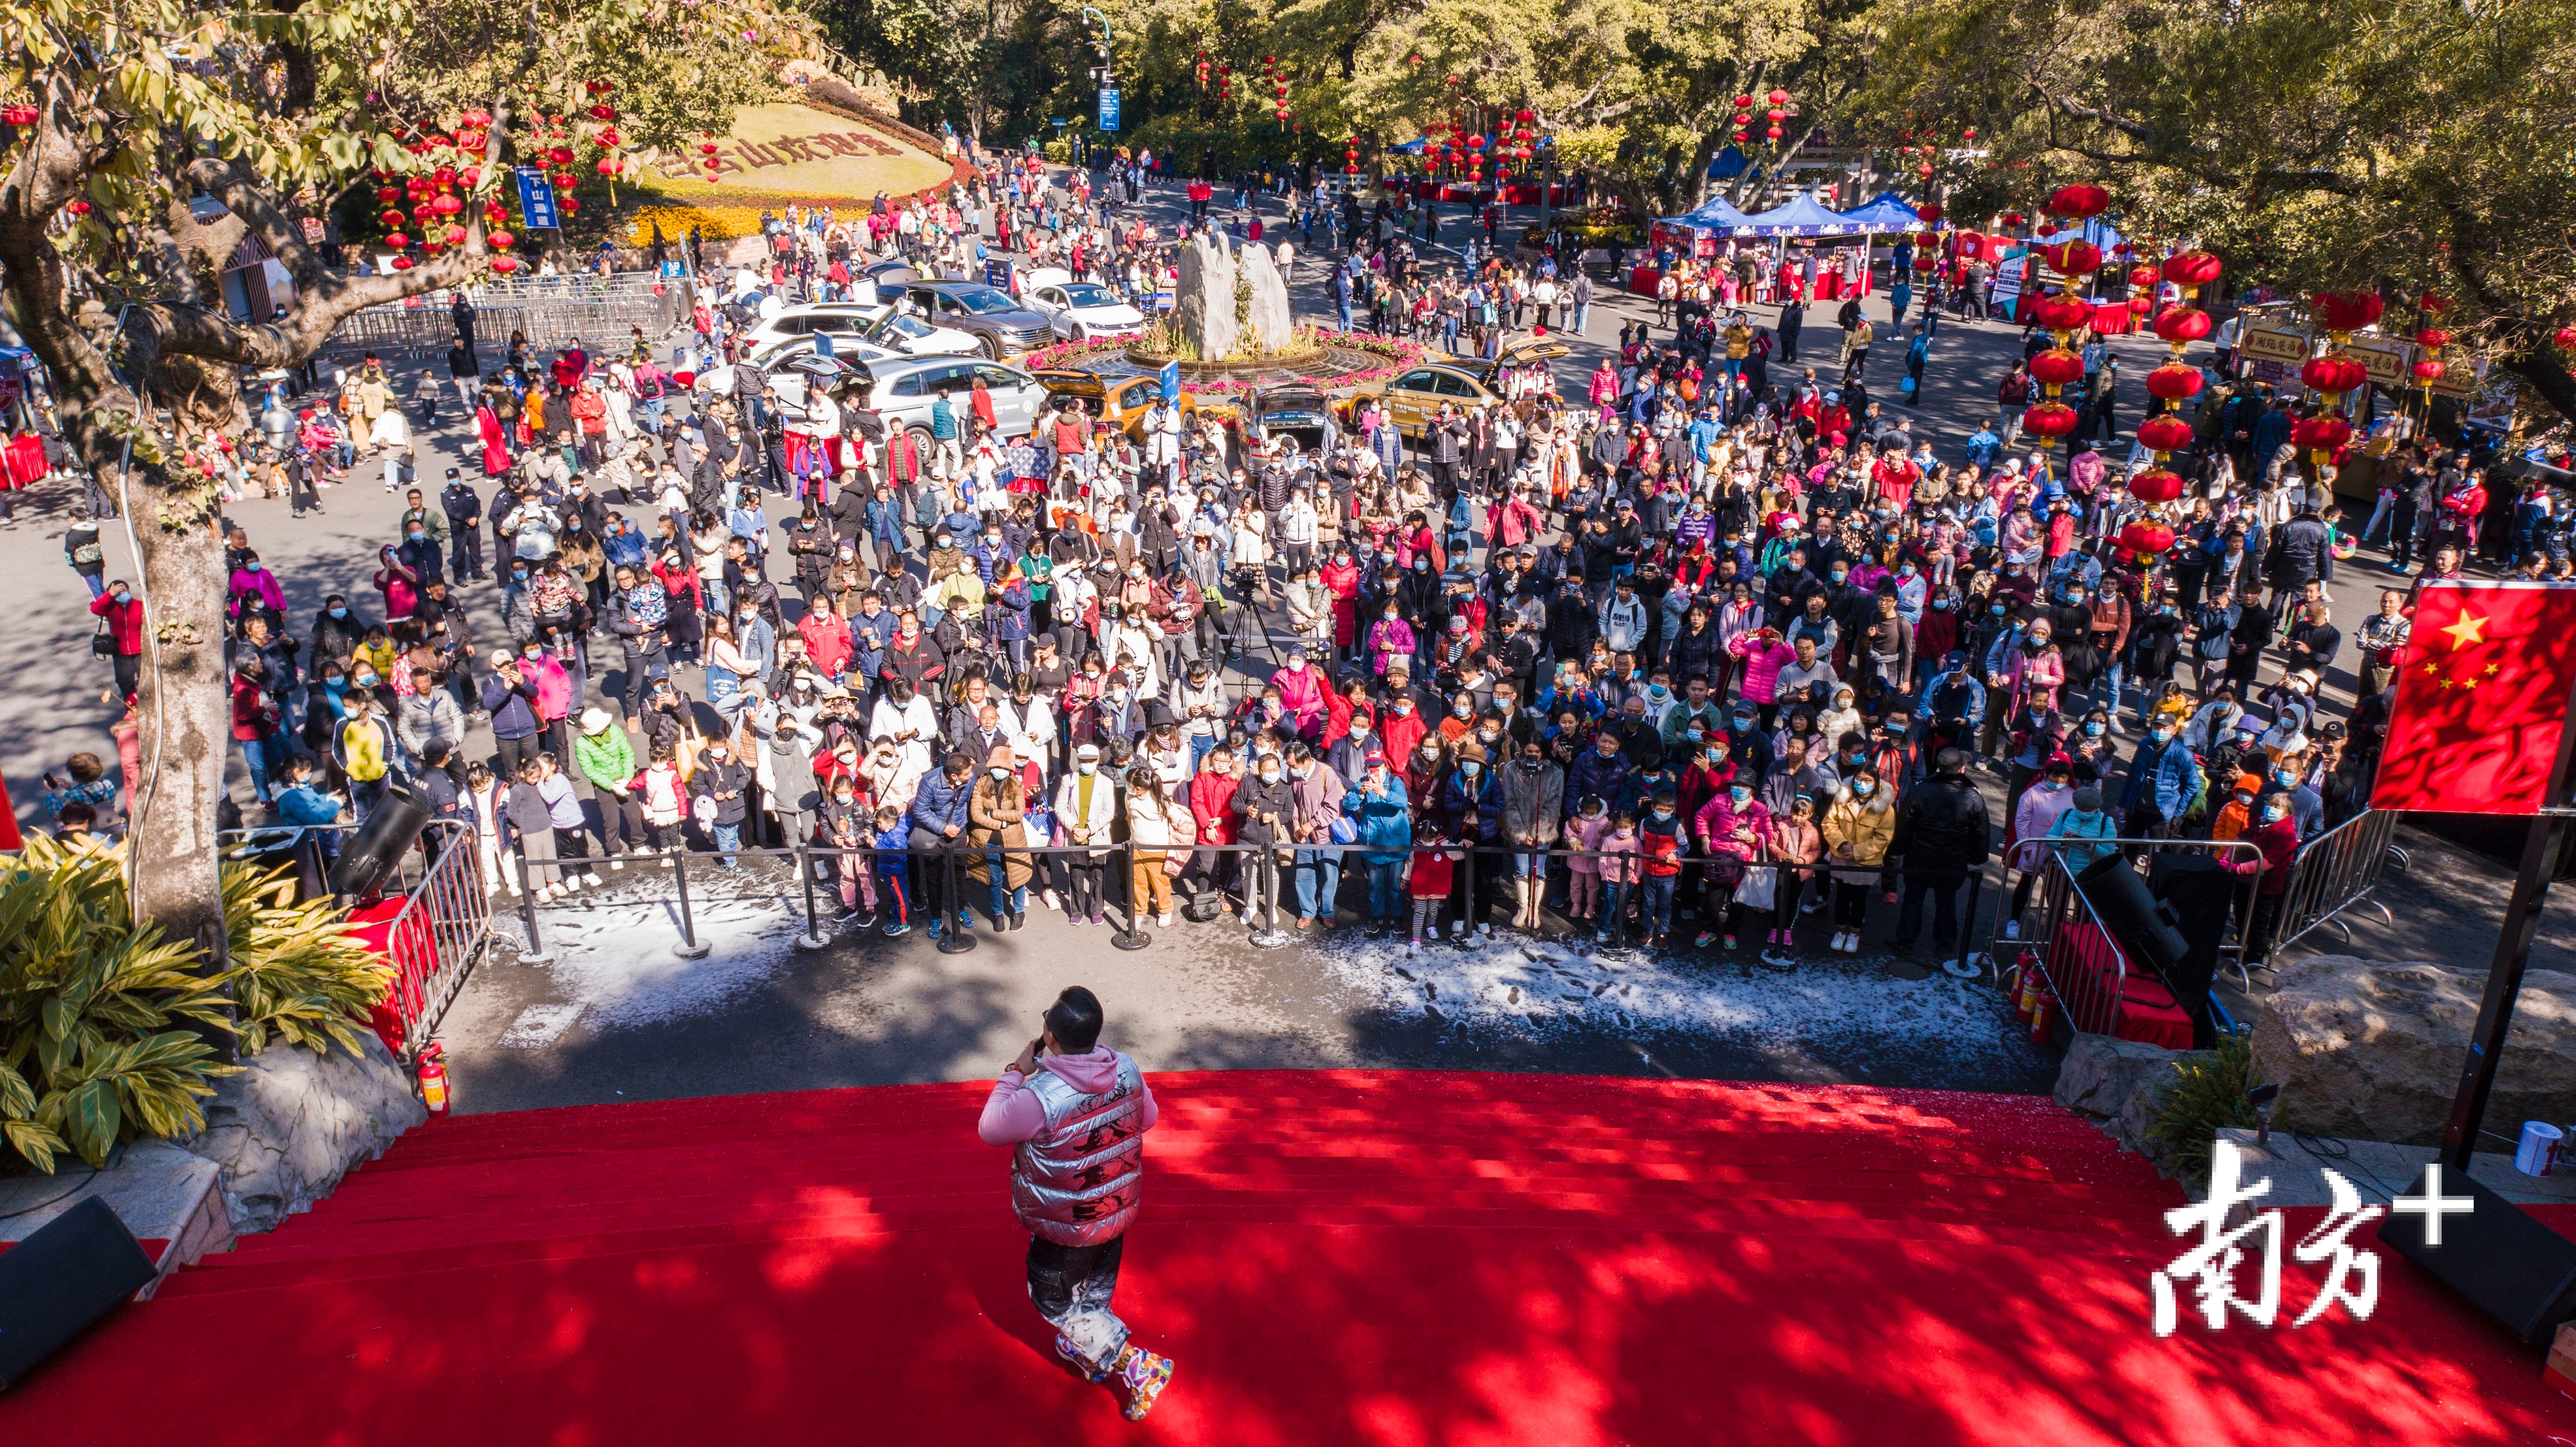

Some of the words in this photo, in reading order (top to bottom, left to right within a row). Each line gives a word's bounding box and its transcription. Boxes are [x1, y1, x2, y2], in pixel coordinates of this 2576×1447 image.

[529, 177, 549, 226] 下山通道
[2255, 337, 2296, 352] 潮玩集市
[1421, 412, 1436, 421] Tigua
